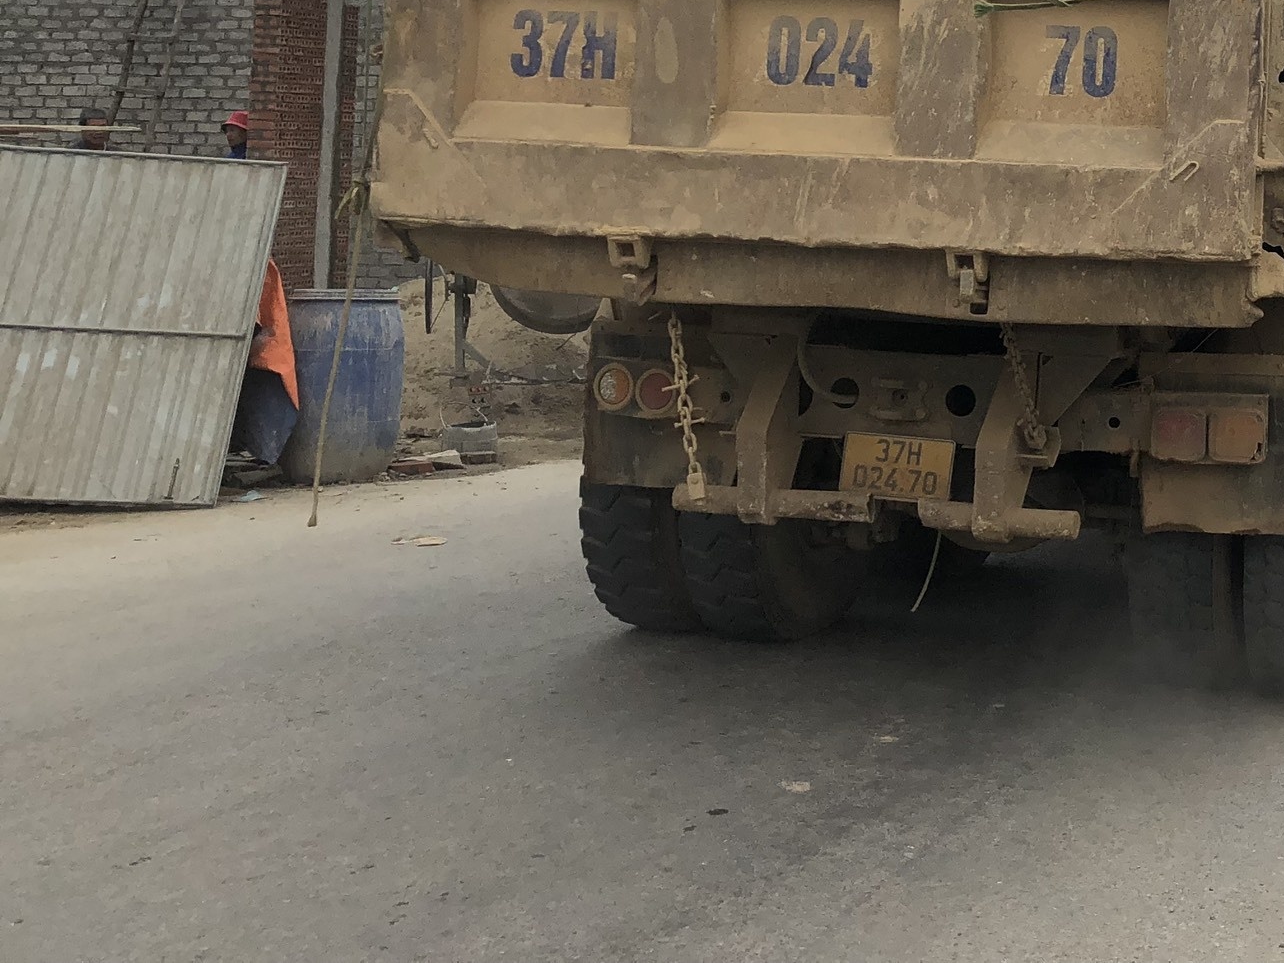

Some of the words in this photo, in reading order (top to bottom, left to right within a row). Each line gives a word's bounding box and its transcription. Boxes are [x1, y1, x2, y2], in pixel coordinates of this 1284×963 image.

[510, 9, 619, 79] 37H
[766, 15, 873, 88] 024
[1045, 25, 1118, 98] 70
[875, 438, 923, 465] 37H
[852, 464, 938, 495] 024.70
